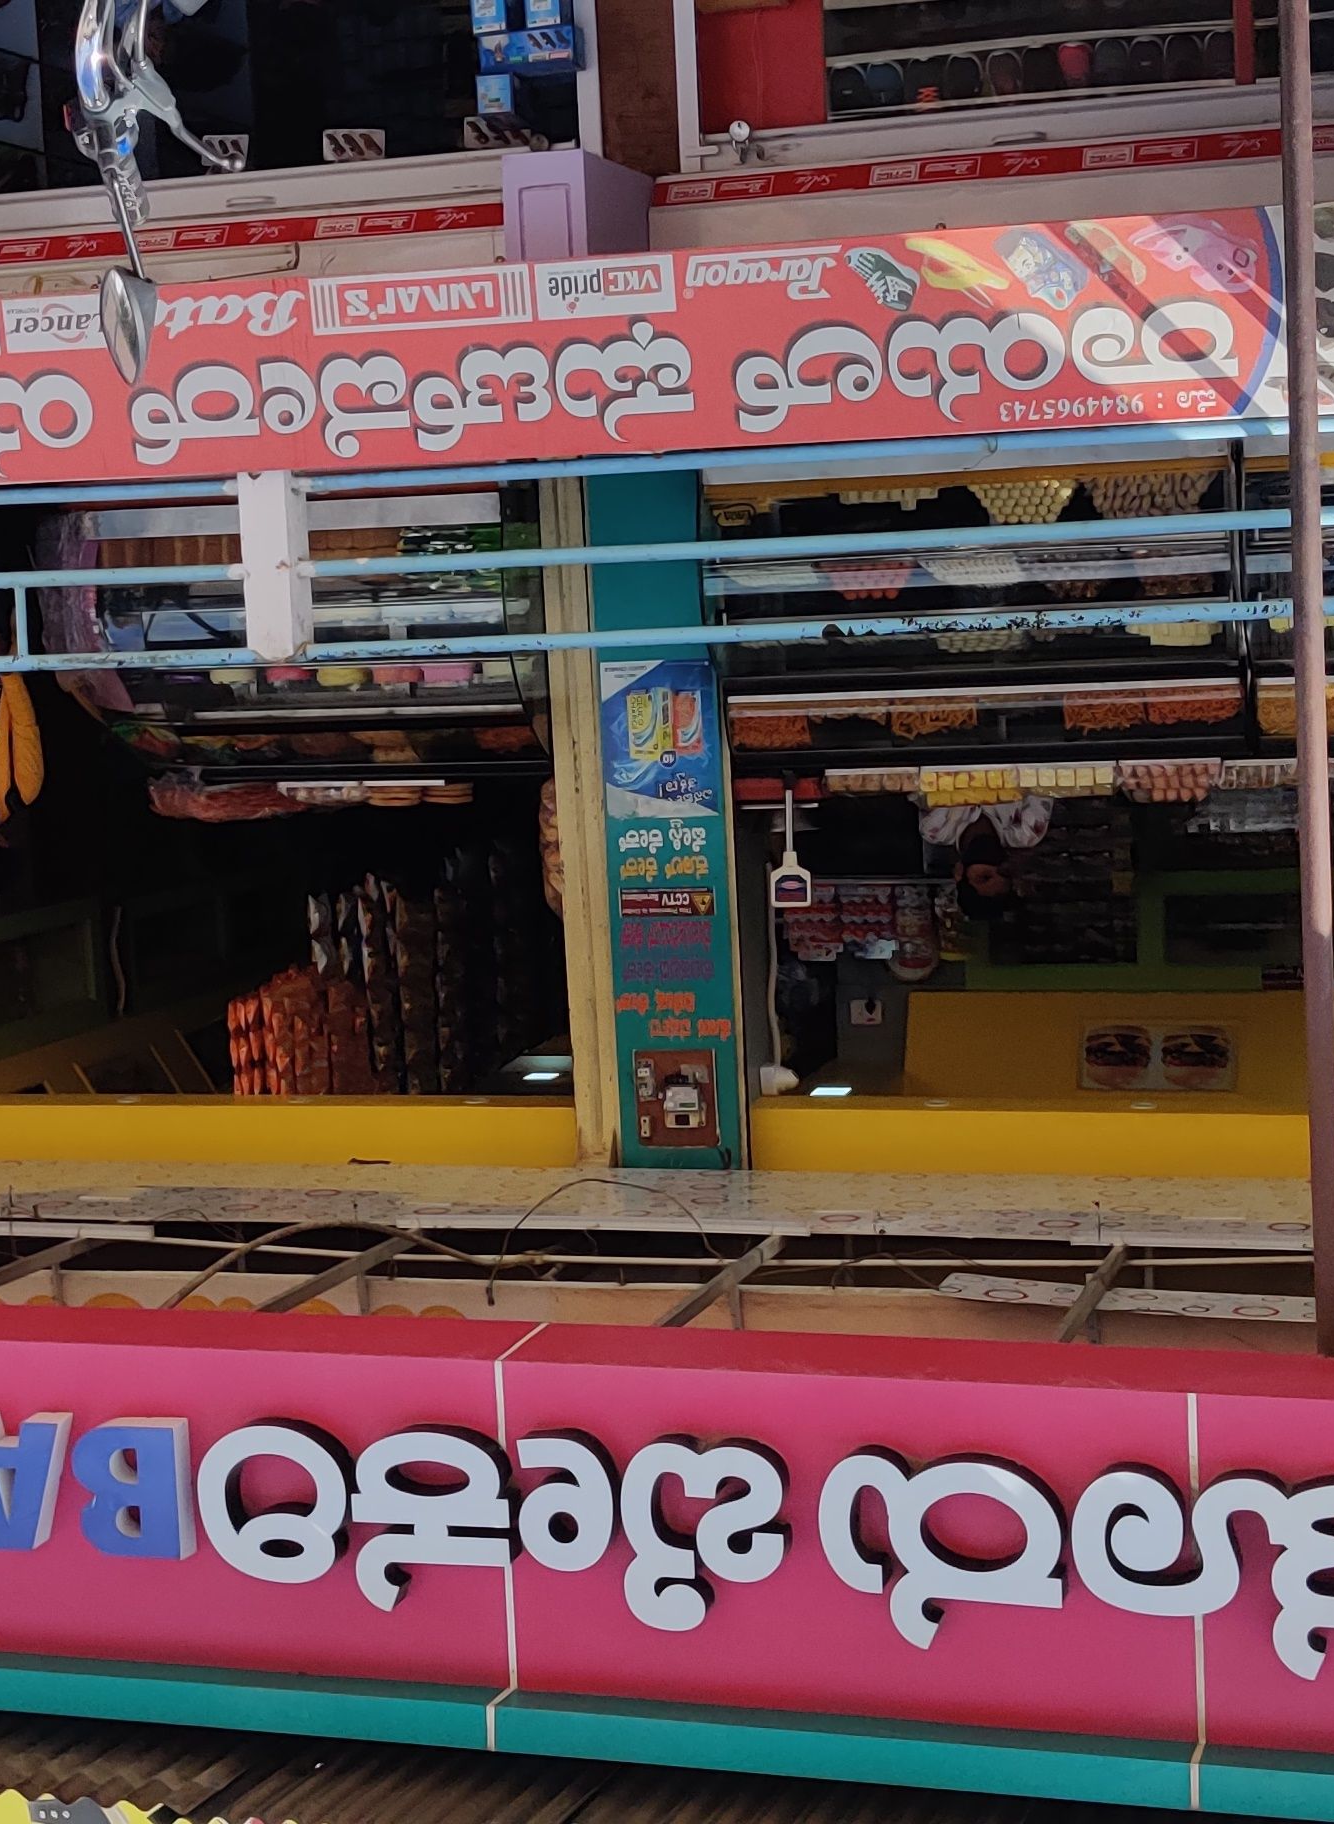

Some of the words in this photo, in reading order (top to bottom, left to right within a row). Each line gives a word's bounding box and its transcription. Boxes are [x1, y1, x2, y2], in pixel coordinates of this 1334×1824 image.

[547, 268, 602, 306] pride
[608, 269, 659, 292] VKC
[684, 253, 837, 299] Paragon
[7, 312, 103, 337] Lancer
[735, 302, 1238, 432] ರಾಯಲ್
[998, 394, 1145, 422] 9844965743
[618, 829, 663, 854] ಕೇಕ್
[620, 856, 658, 882] ಕೇಕ್
[661, 893, 690, 906] CCTV
[196, 1420, 789, 1633] ಬೇಕರಿ
